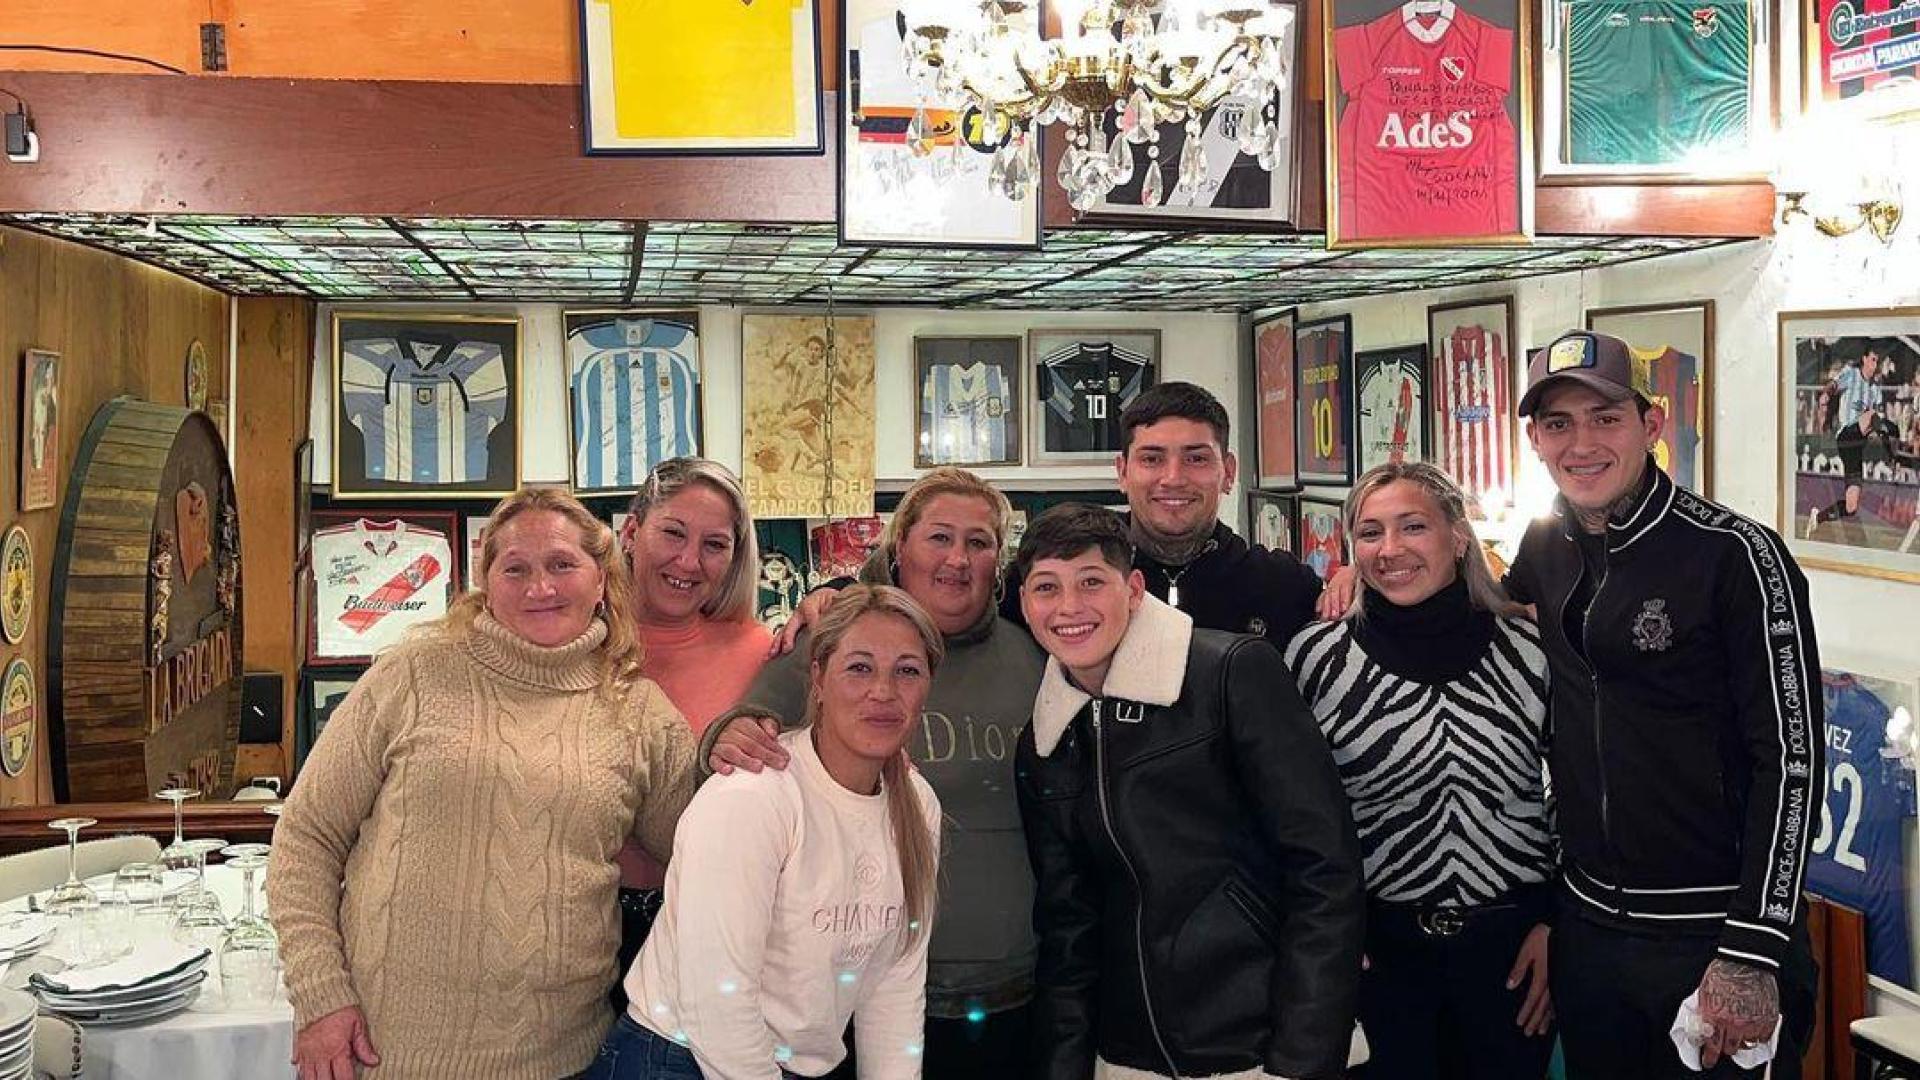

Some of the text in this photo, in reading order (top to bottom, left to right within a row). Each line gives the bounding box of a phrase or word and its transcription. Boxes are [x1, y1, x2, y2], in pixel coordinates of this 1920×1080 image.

[1376, 110, 1474, 149] AdeS
[1086, 395, 1107, 418] 10
[1312, 398, 1332, 458] 10
